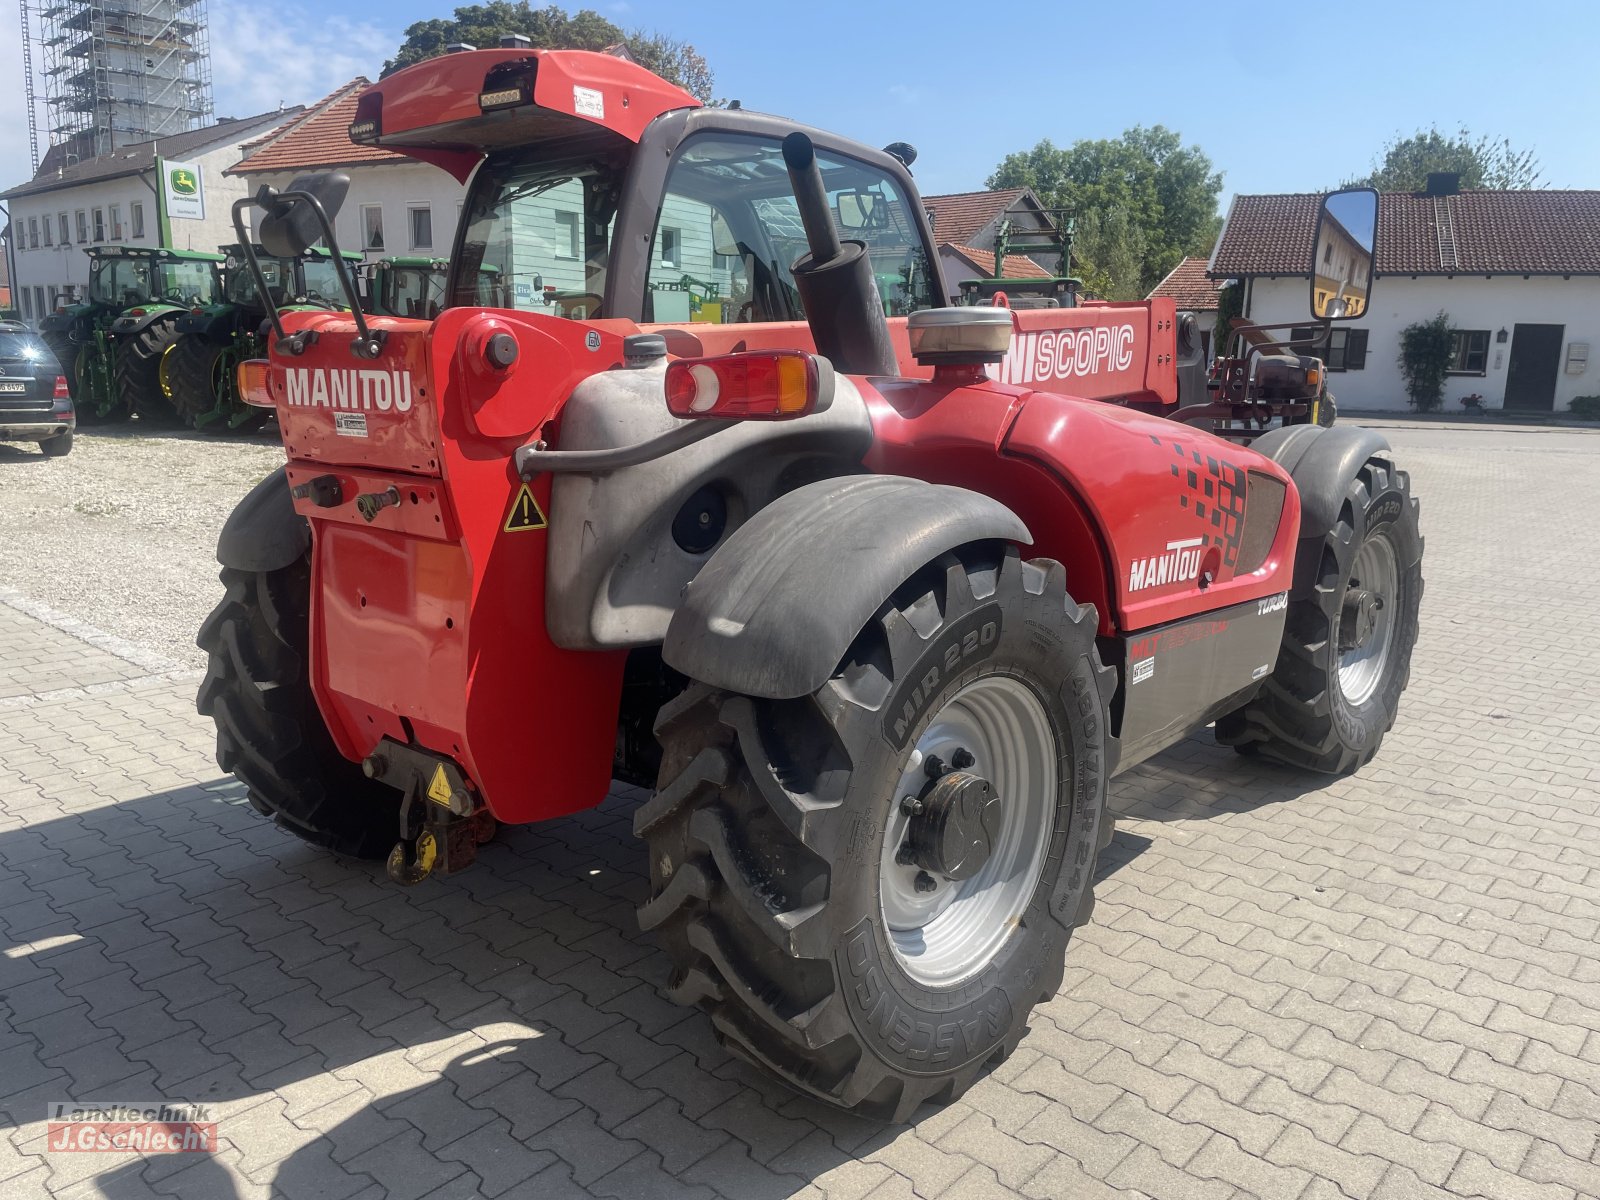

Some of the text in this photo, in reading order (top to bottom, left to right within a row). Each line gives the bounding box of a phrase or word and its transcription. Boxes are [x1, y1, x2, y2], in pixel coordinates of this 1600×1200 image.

[286, 368, 411, 411] MANITOU
[1129, 538, 1202, 592] MANITOU
[1257, 591, 1289, 616] TURBO
[1129, 633, 1162, 664] MLT
[893, 621, 997, 740] MIR 220
[846, 930, 985, 1063] ASCENSO
